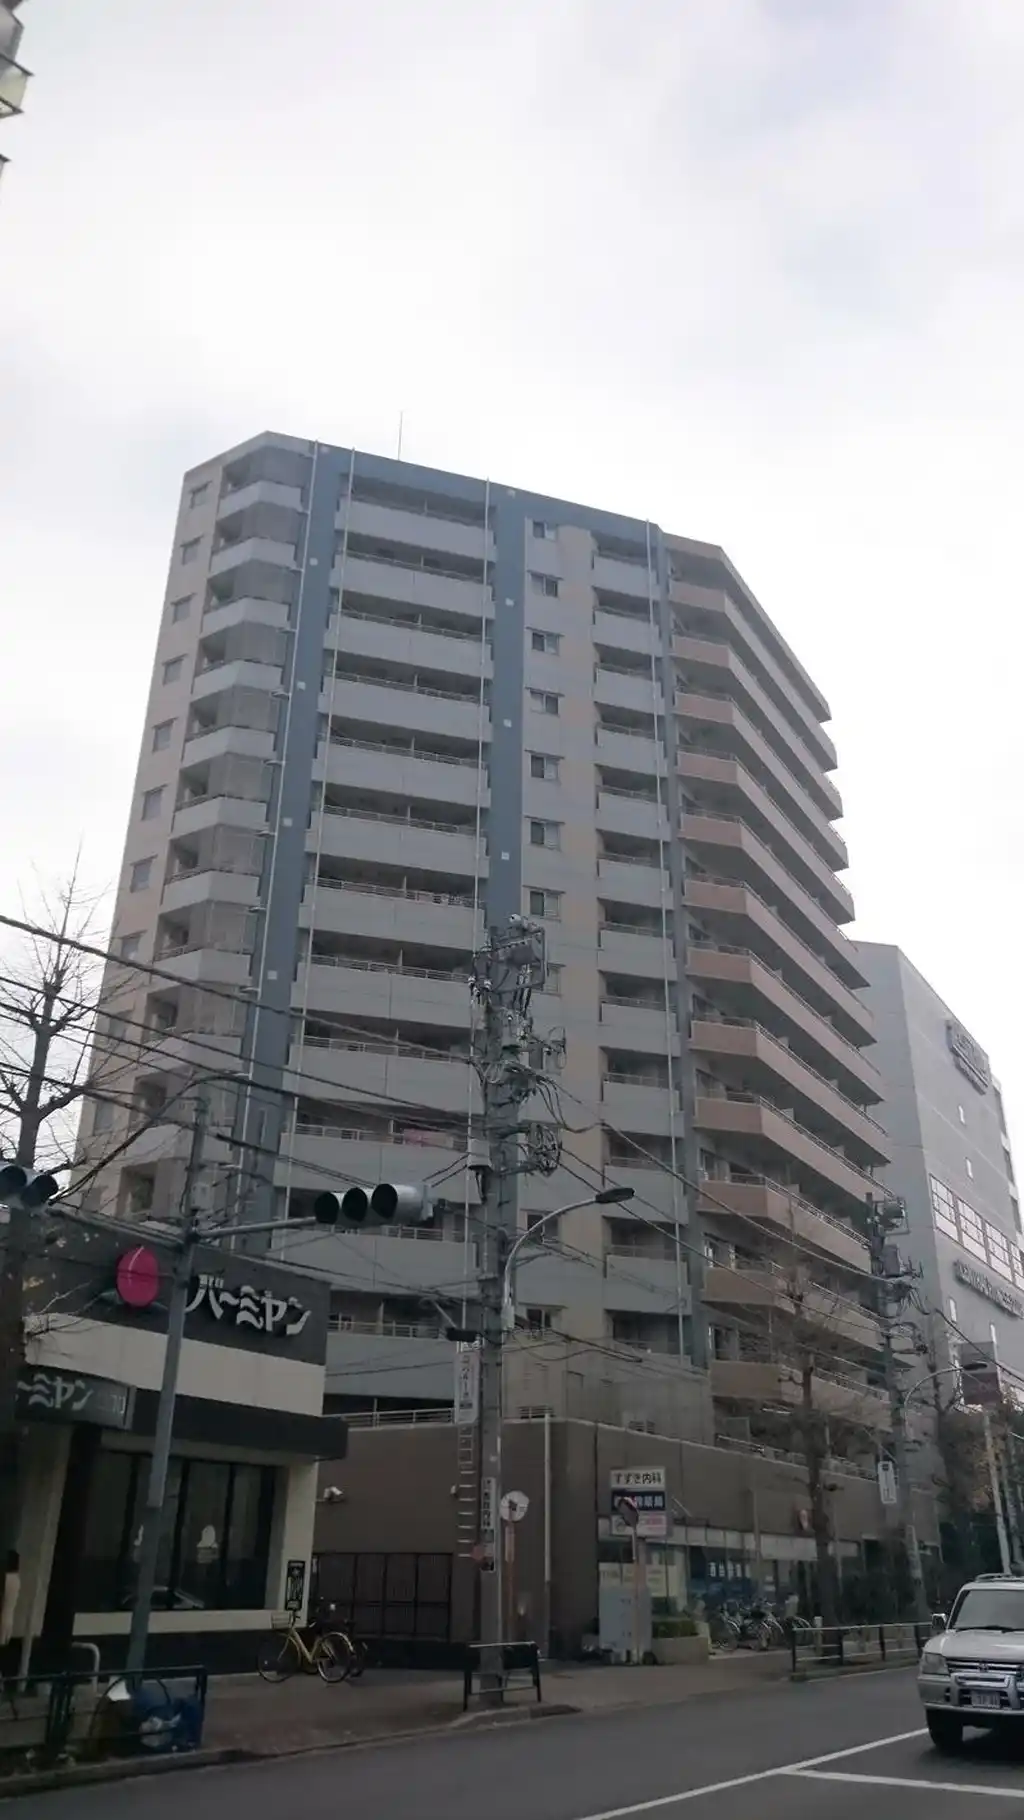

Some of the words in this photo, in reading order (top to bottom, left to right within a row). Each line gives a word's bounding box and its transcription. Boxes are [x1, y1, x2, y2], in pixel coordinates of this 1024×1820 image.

[185, 1273, 311, 1336] バーミヤン
[15, 1372, 94, 1412] ーミヤン
